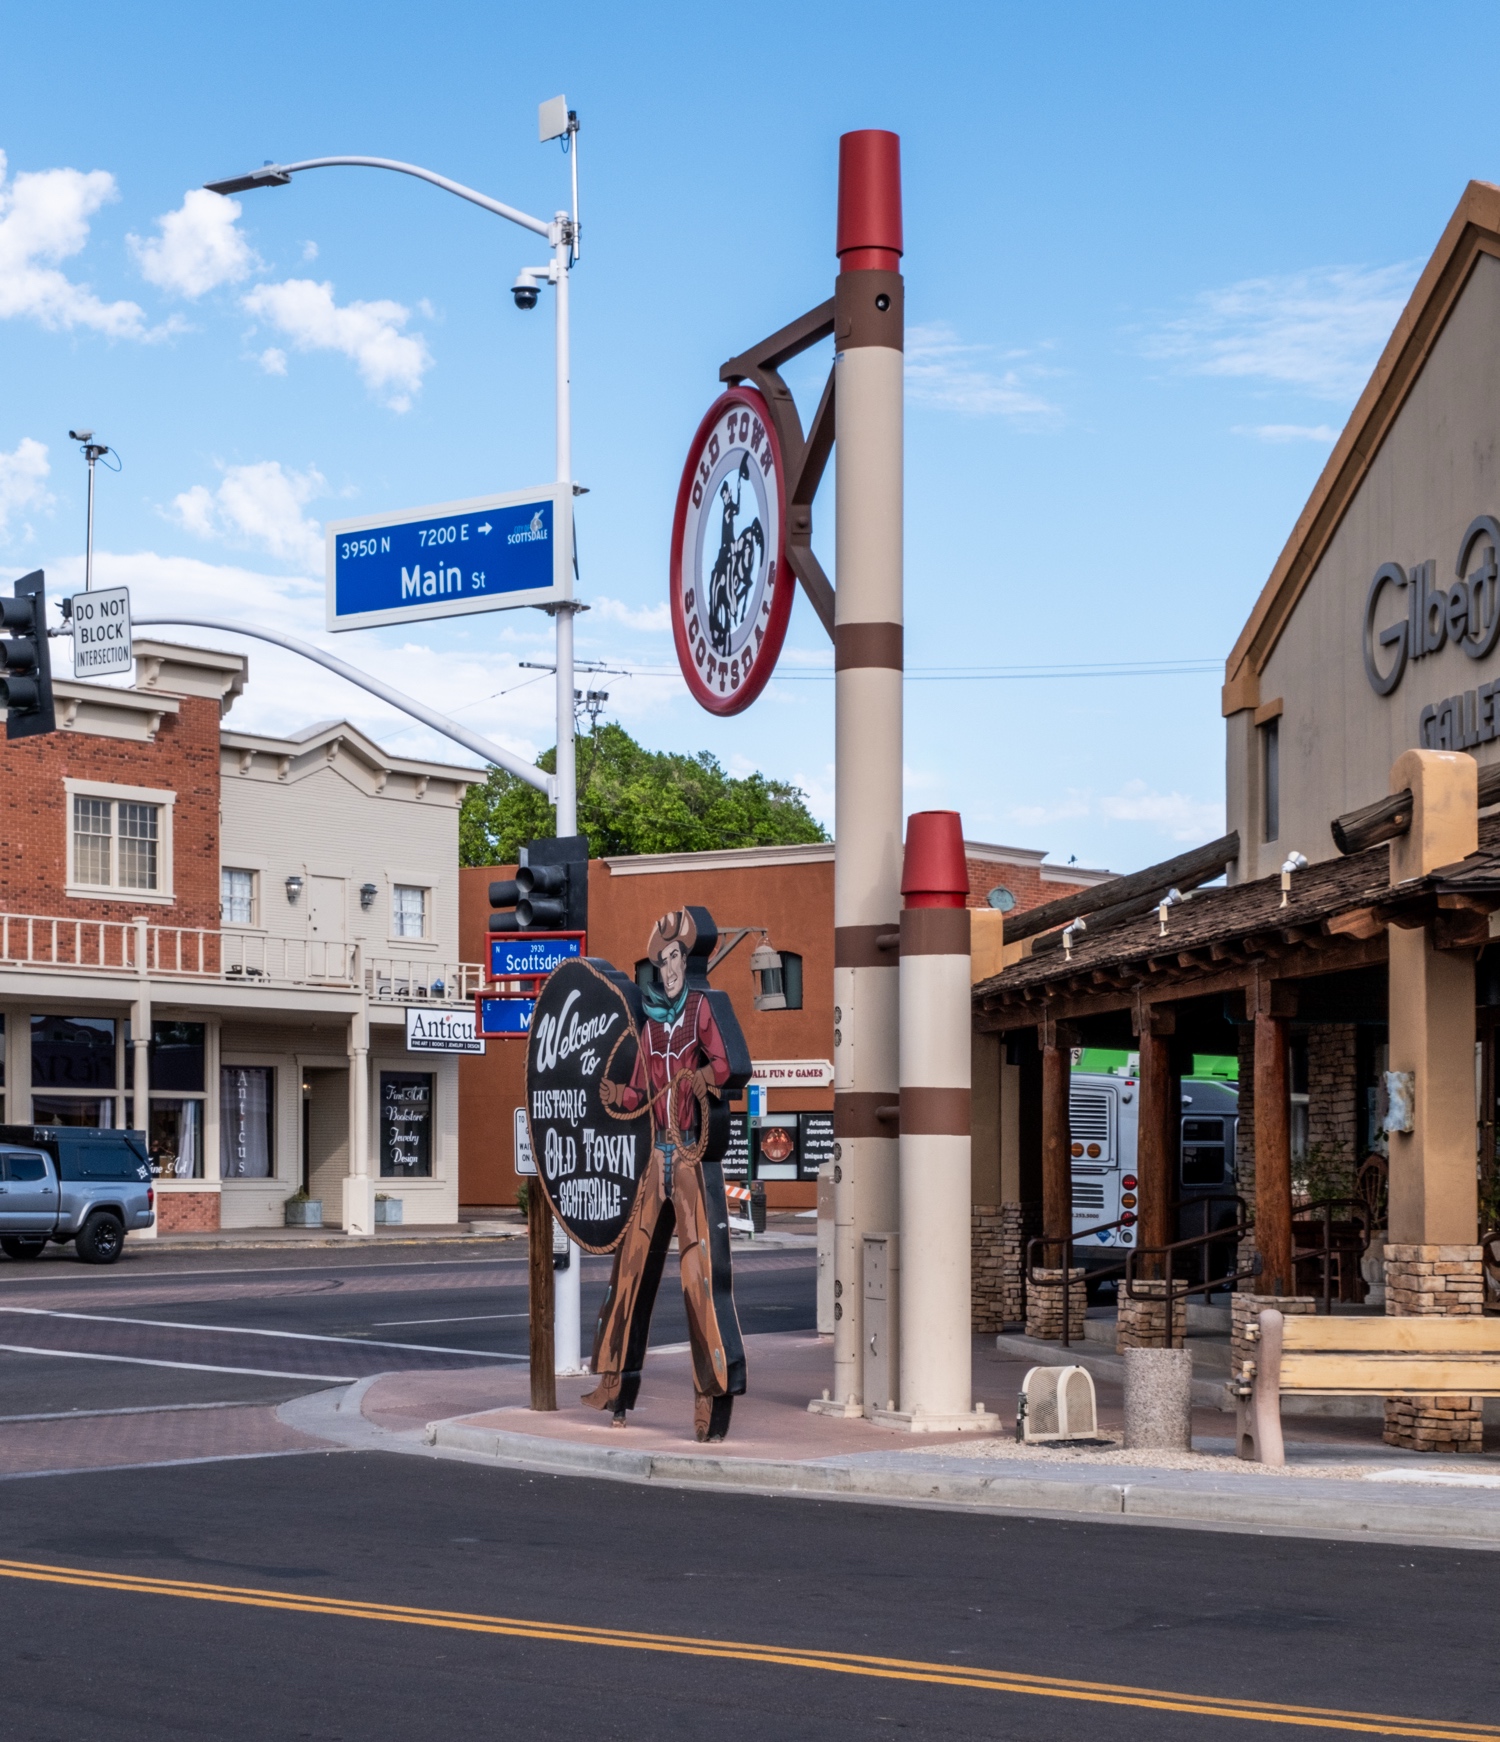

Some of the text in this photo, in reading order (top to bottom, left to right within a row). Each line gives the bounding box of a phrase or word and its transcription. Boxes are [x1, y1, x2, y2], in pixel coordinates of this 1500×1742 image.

[691, 412, 774, 510] OLD TOWN
[341, 524, 469, 560] 3950 N 7200 E
[507, 529, 548, 545] SCOTTSDALE
[401, 561, 486, 600] Main St
[76, 599, 126, 622] DO NOT
[1362, 546, 1498, 698] Gilbert
[81, 622, 123, 644] BLOCK
[685, 560, 776, 692] SCOTTSDALE
[77, 645, 129, 668] INTERSECTION
[495, 944, 577, 954] N 3930 Rd
[486, 1003, 492, 1011] E
[410, 1013, 477, 1040] Anticu
[536, 989, 619, 1073] Welcome
[580, 1048, 601, 1076] to
[769, 1069, 785, 1078] FUN
[787, 1069, 794, 1078] &
[795, 1068, 823, 1078] GAMES
[386, 1084, 423, 1101] Fine Art
[386, 1105, 424, 1121] Bookstore
[532, 1089, 587, 1127] HISTORIC
[237, 1071, 248, 1173] Anticus
[389, 1126, 420, 1146] Jewelry
[806, 1140, 820, 1148] Jelly
[390, 1147, 418, 1166] Design
[544, 1127, 637, 1180] OLD TOWN
[559, 1178, 621, 1221] SCOTTSDALE
